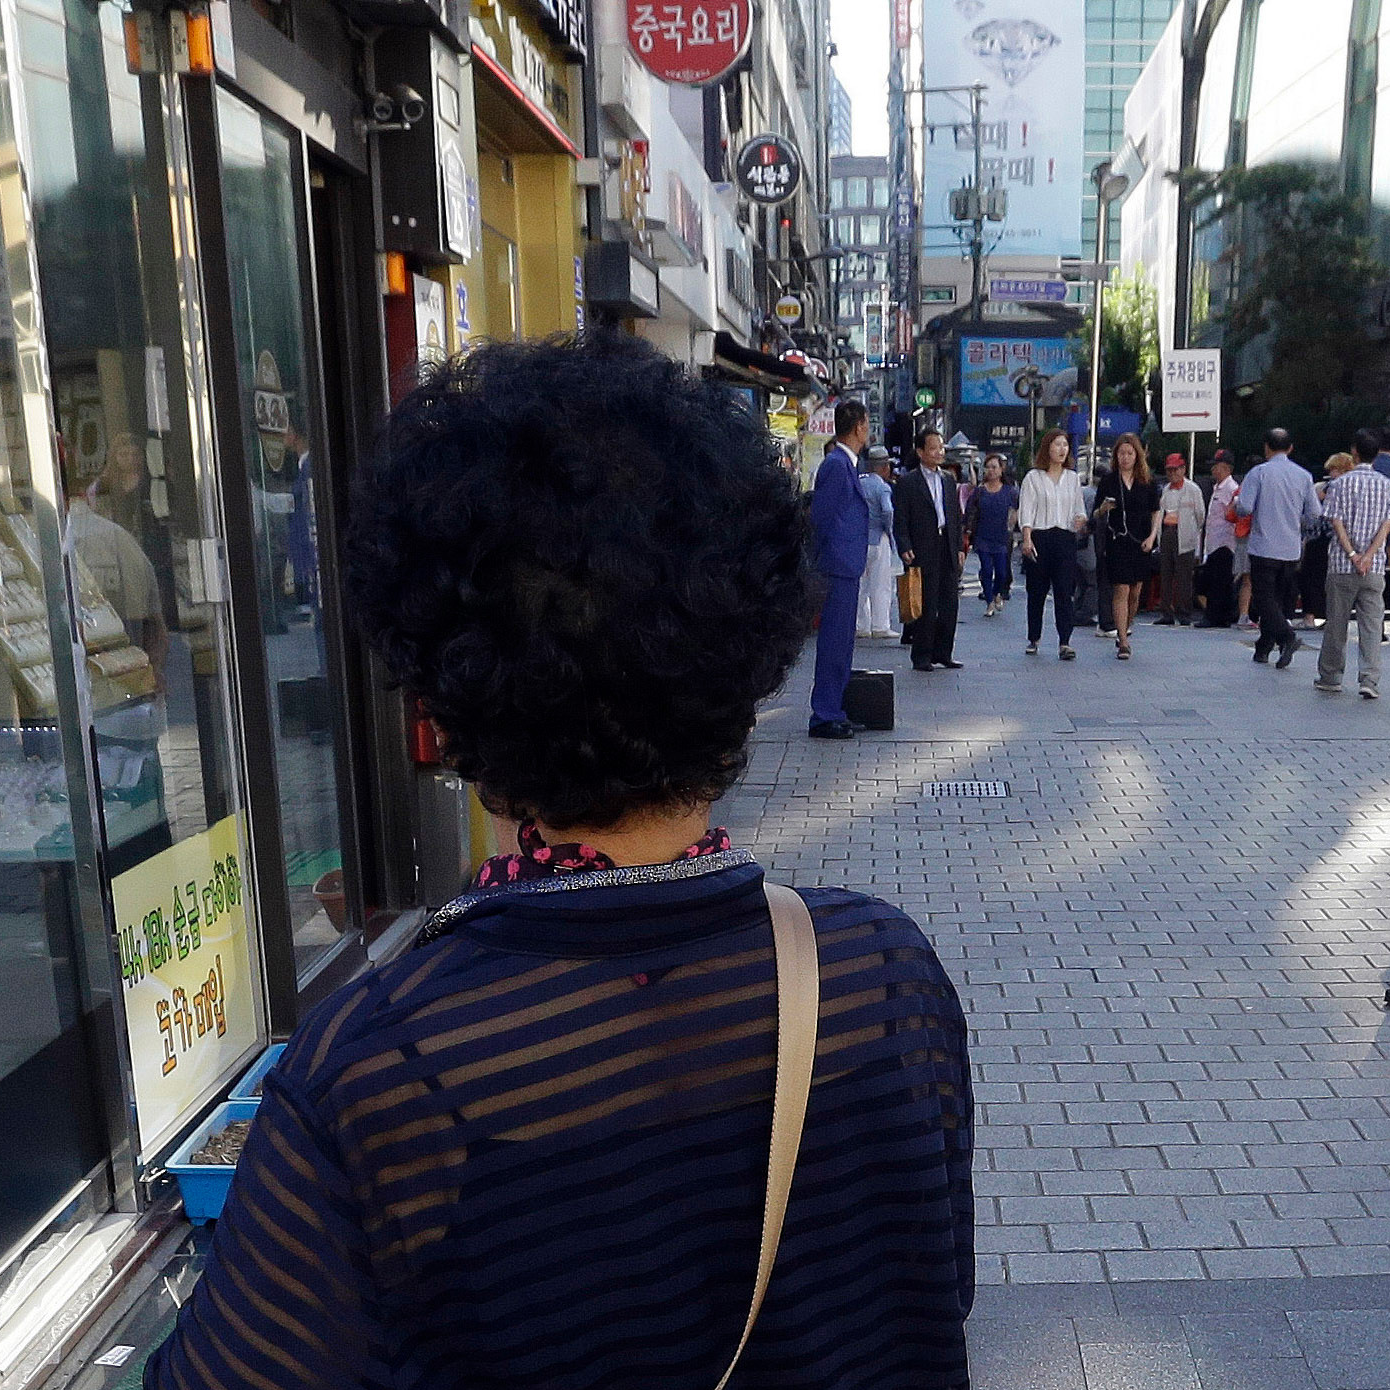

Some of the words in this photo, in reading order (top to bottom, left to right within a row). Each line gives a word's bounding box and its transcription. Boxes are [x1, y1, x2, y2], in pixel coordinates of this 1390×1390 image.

[632, 3, 741, 53] 중국요리
[966, 340, 1033, 365] 콜라텍
[1167, 360, 1216, 383] 주차장입구
[142, 906, 172, 973] 18k
[172, 879, 202, 962] 순금
[201, 852, 242, 928] 다이아
[155, 986, 193, 1078] 고가
[192, 953, 227, 1039] 매입
